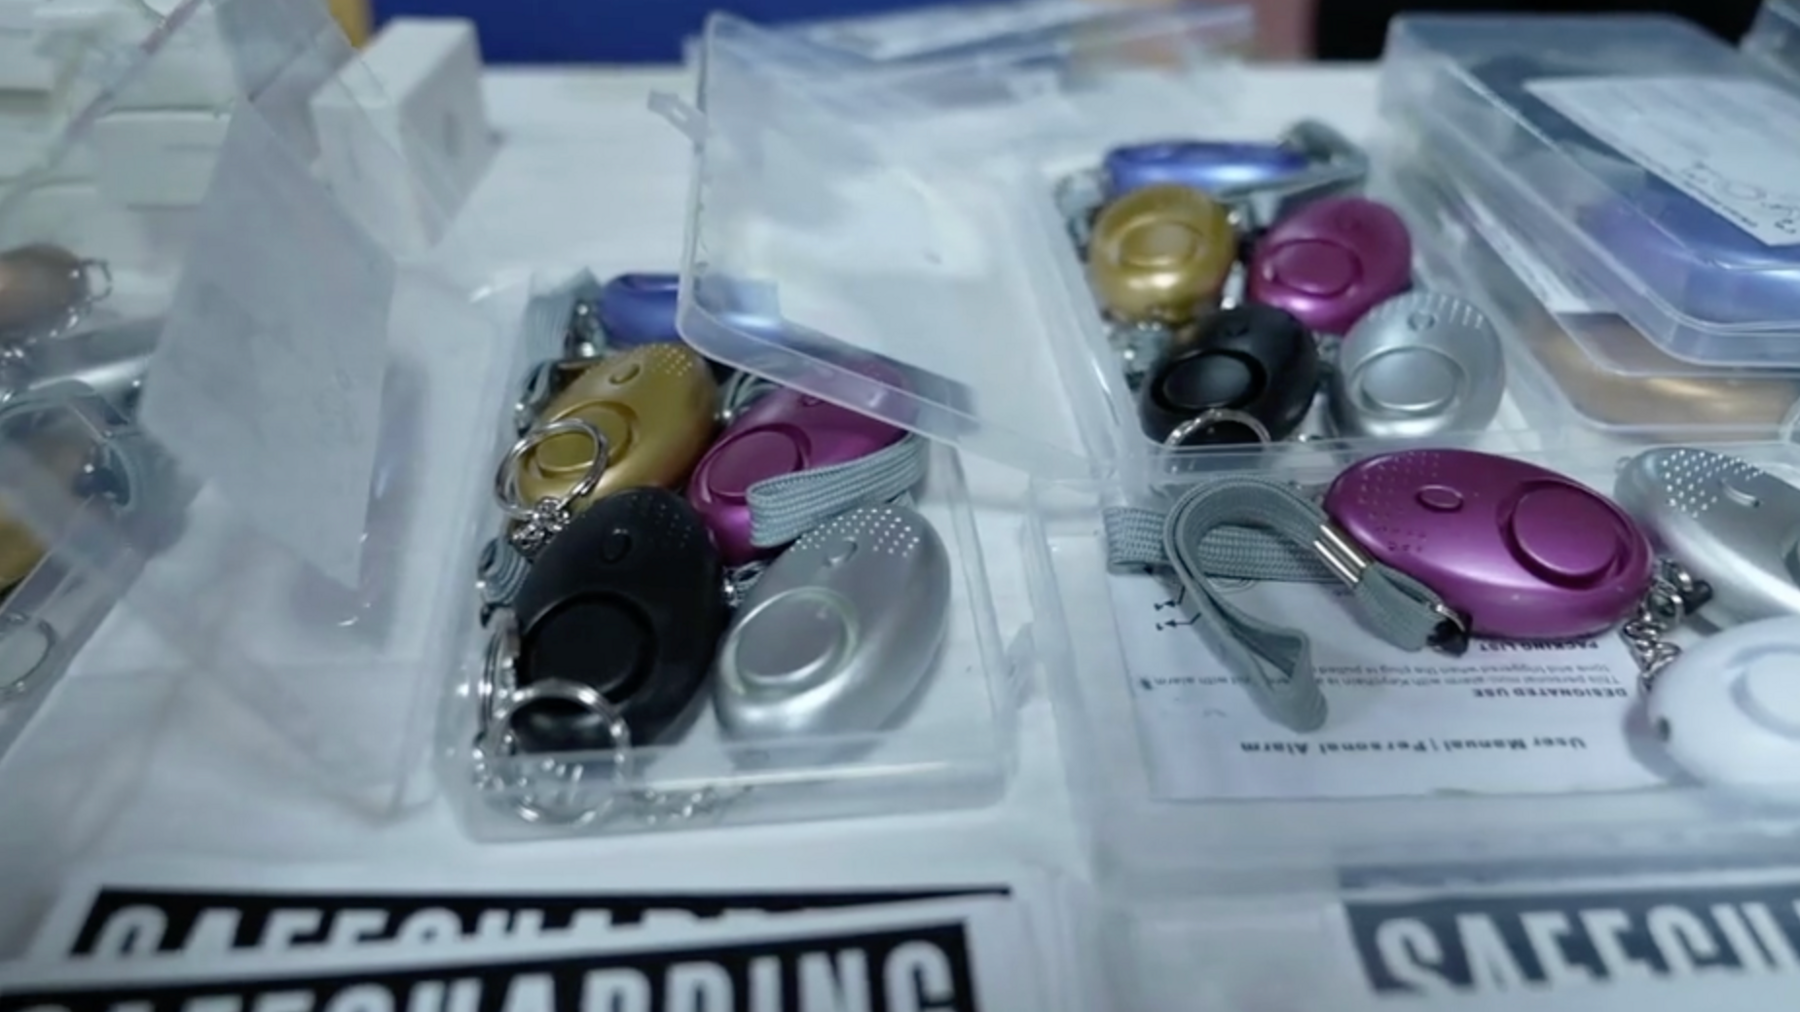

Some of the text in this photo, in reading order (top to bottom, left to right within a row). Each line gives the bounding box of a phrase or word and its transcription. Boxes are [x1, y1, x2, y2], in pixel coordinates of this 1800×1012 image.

[1471, 687, 1628, 697] DESIGNATED USE
[1239, 741, 1308, 756] Alarm
[1318, 740, 1427, 756] Personal
[1443, 737, 1528, 753] Manual
[1533, 736, 1588, 751] User
